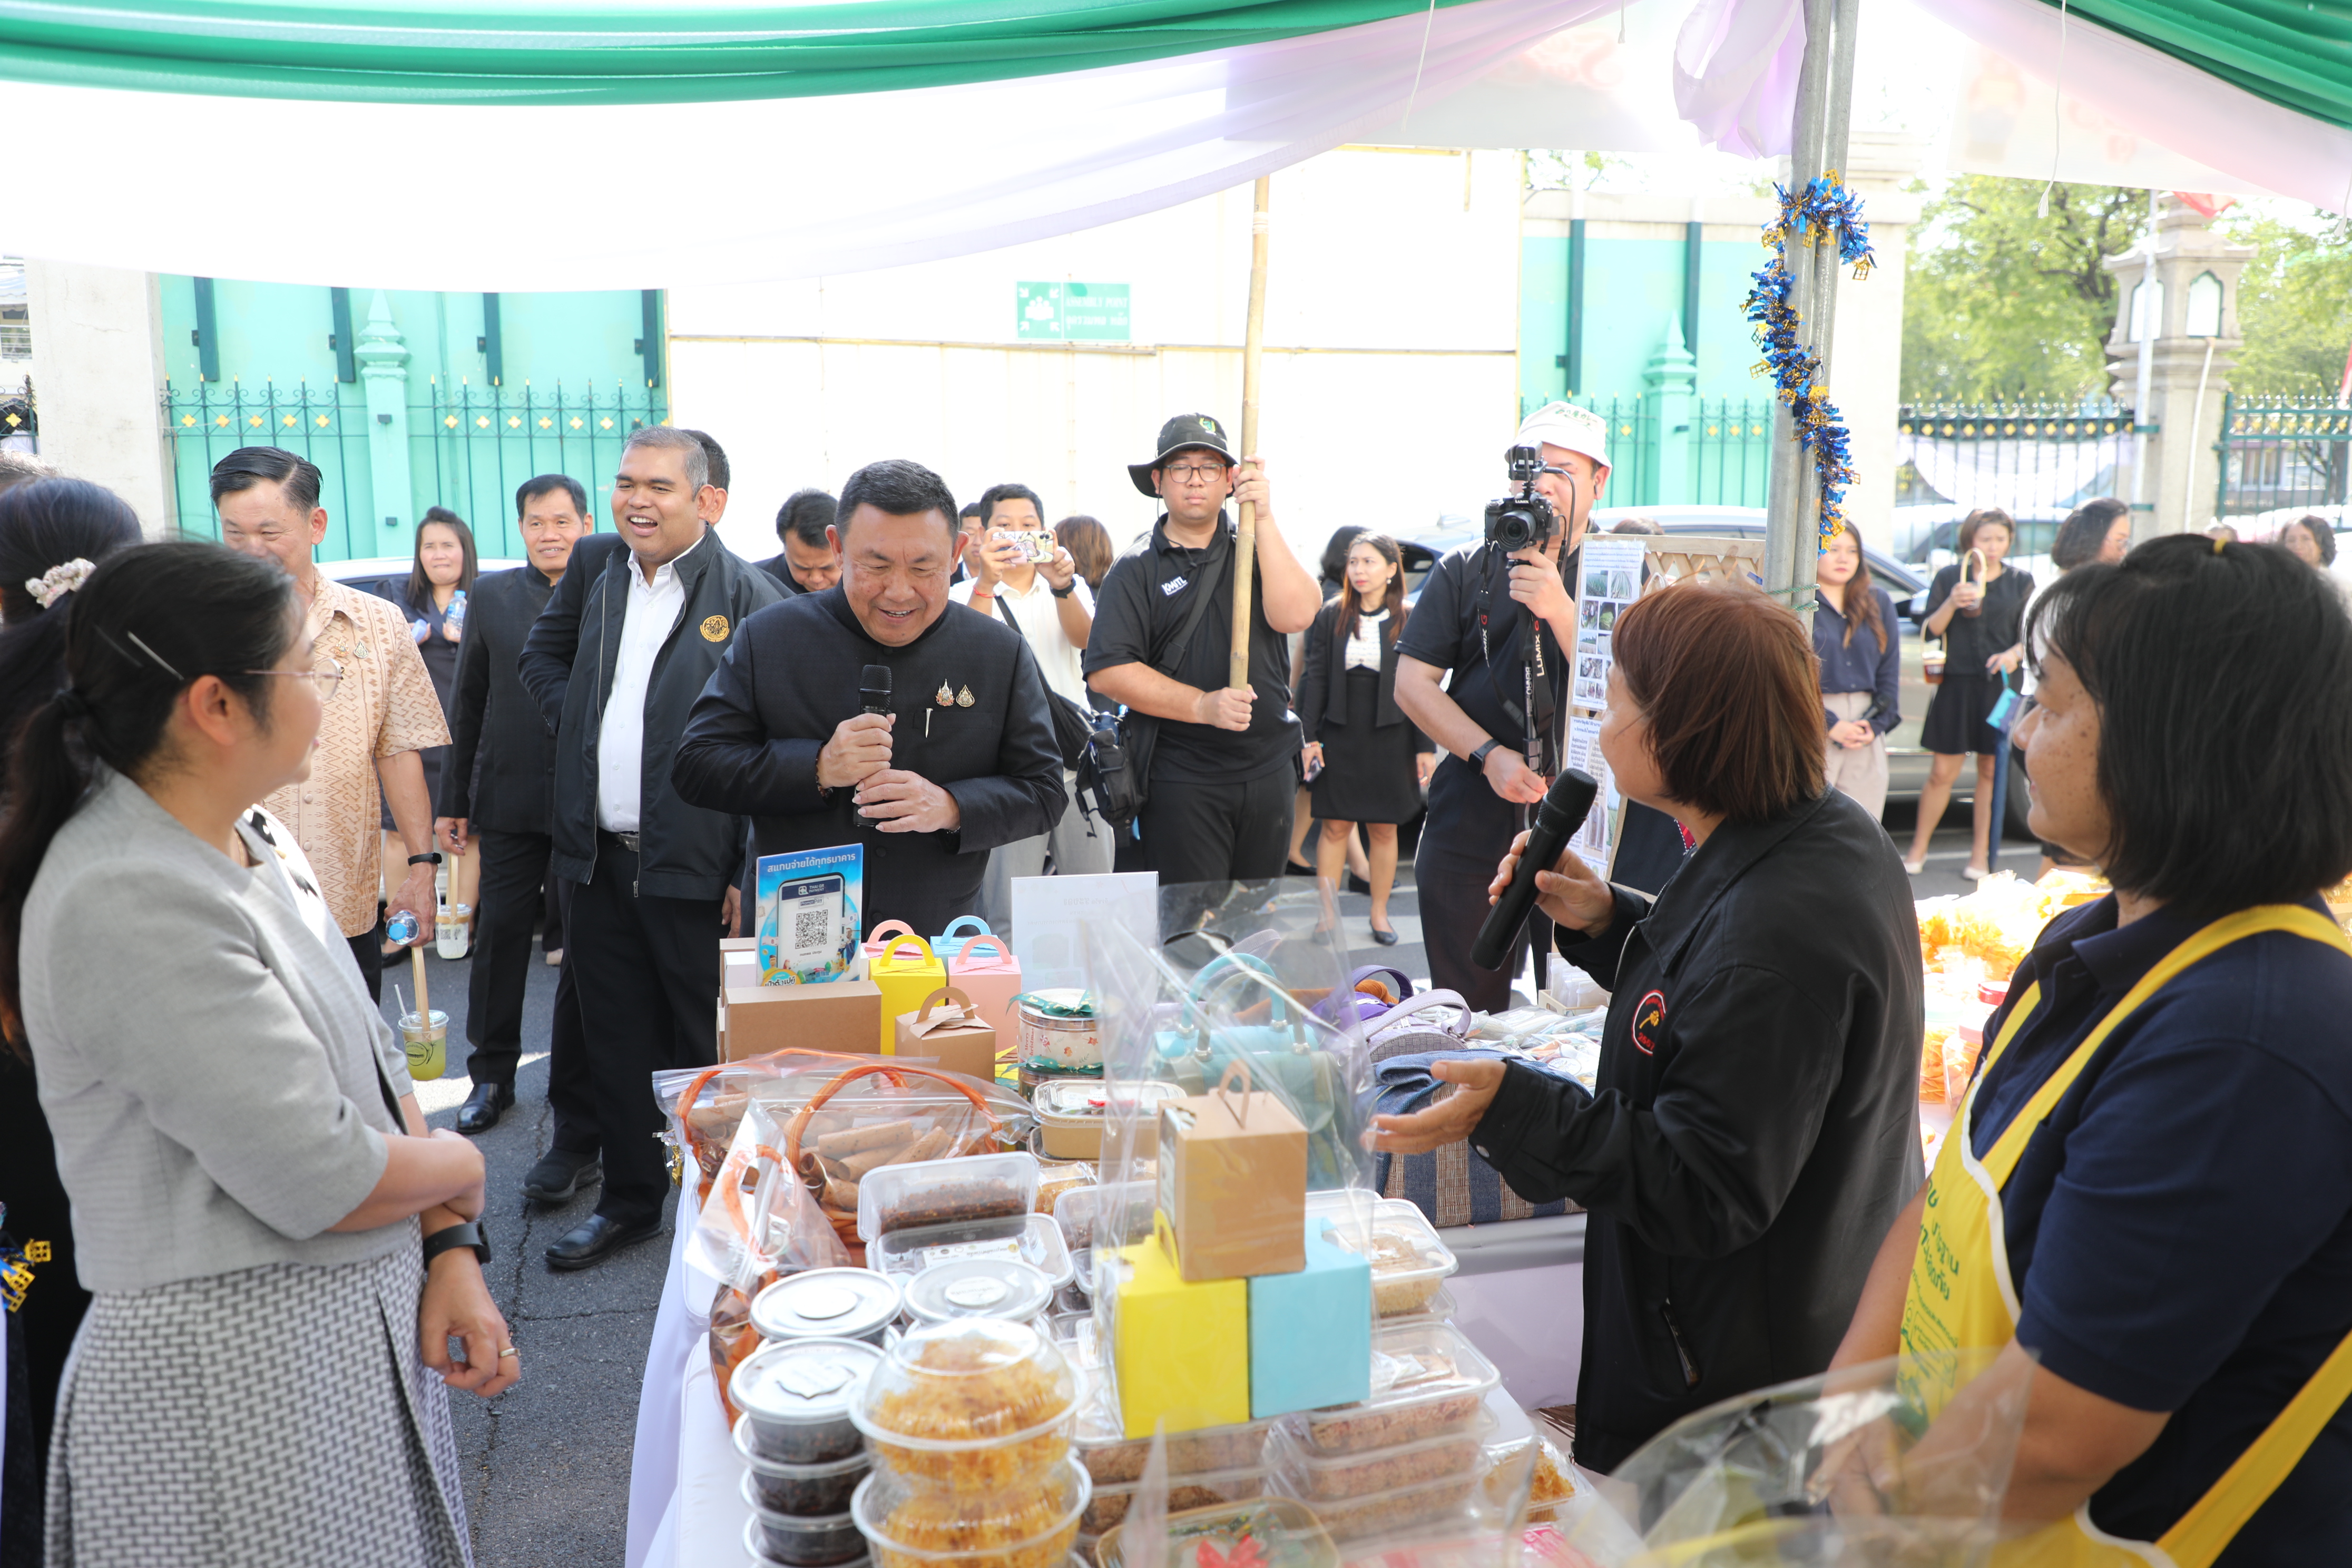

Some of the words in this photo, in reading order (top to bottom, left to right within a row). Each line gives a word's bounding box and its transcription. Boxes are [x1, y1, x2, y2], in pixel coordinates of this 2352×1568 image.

[1065, 296, 1103, 307] ASSEMBLY
[1105, 297, 1128, 308] POINT
[1161, 575, 1188, 596] KMITL
[1534, 620, 1540, 631] G
[1534, 634, 1545, 677] LUMIX
[1525, 666, 1534, 696] BENRO
[767, 852, 856, 873] สแกนจ่ายได้ทุกธนาคาร
